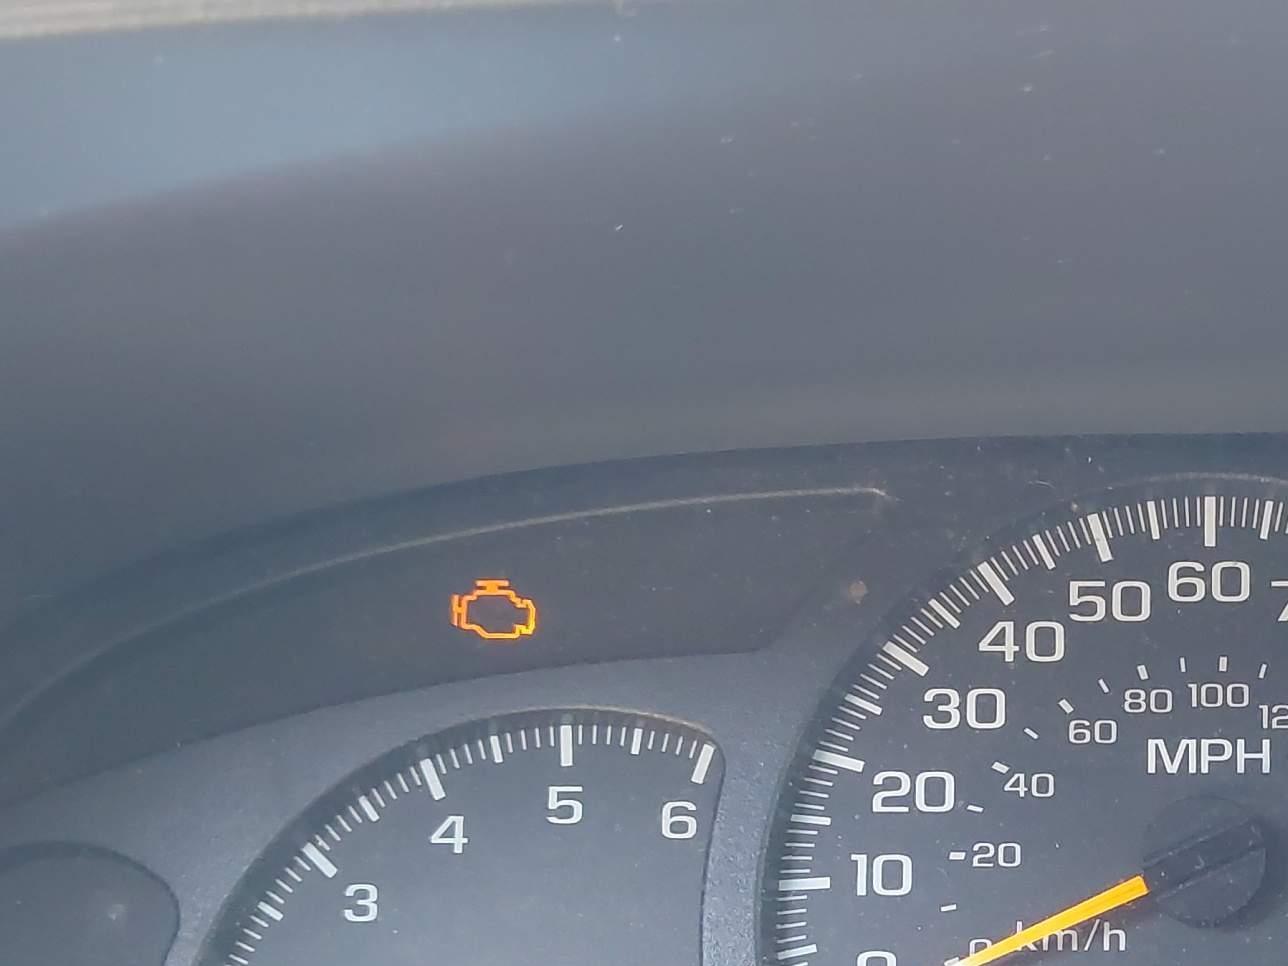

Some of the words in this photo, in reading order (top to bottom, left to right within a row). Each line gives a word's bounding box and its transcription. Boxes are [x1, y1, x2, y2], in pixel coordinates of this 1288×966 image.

[1167, 561, 1251, 602] 60
[1069, 580, 1151, 622] 50
[978, 621, 1065, 663] 40
[923, 688, 1006, 729] 30
[1124, 689, 1173, 713] 80
[1187, 683, 1249, 708] 100
[1068, 719, 1117, 744] 60
[1147, 738, 1271, 774] MPH
[872, 771, 955, 813] 20
[1003, 773, 1055, 798] 40
[546, 786, 583, 824] 5
[661, 801, 697, 839] 6
[430, 815, 469, 854] 4
[972, 842, 1021, 867] 20
[850, 853, 913, 896] 10
[343, 883, 378, 922] 3
